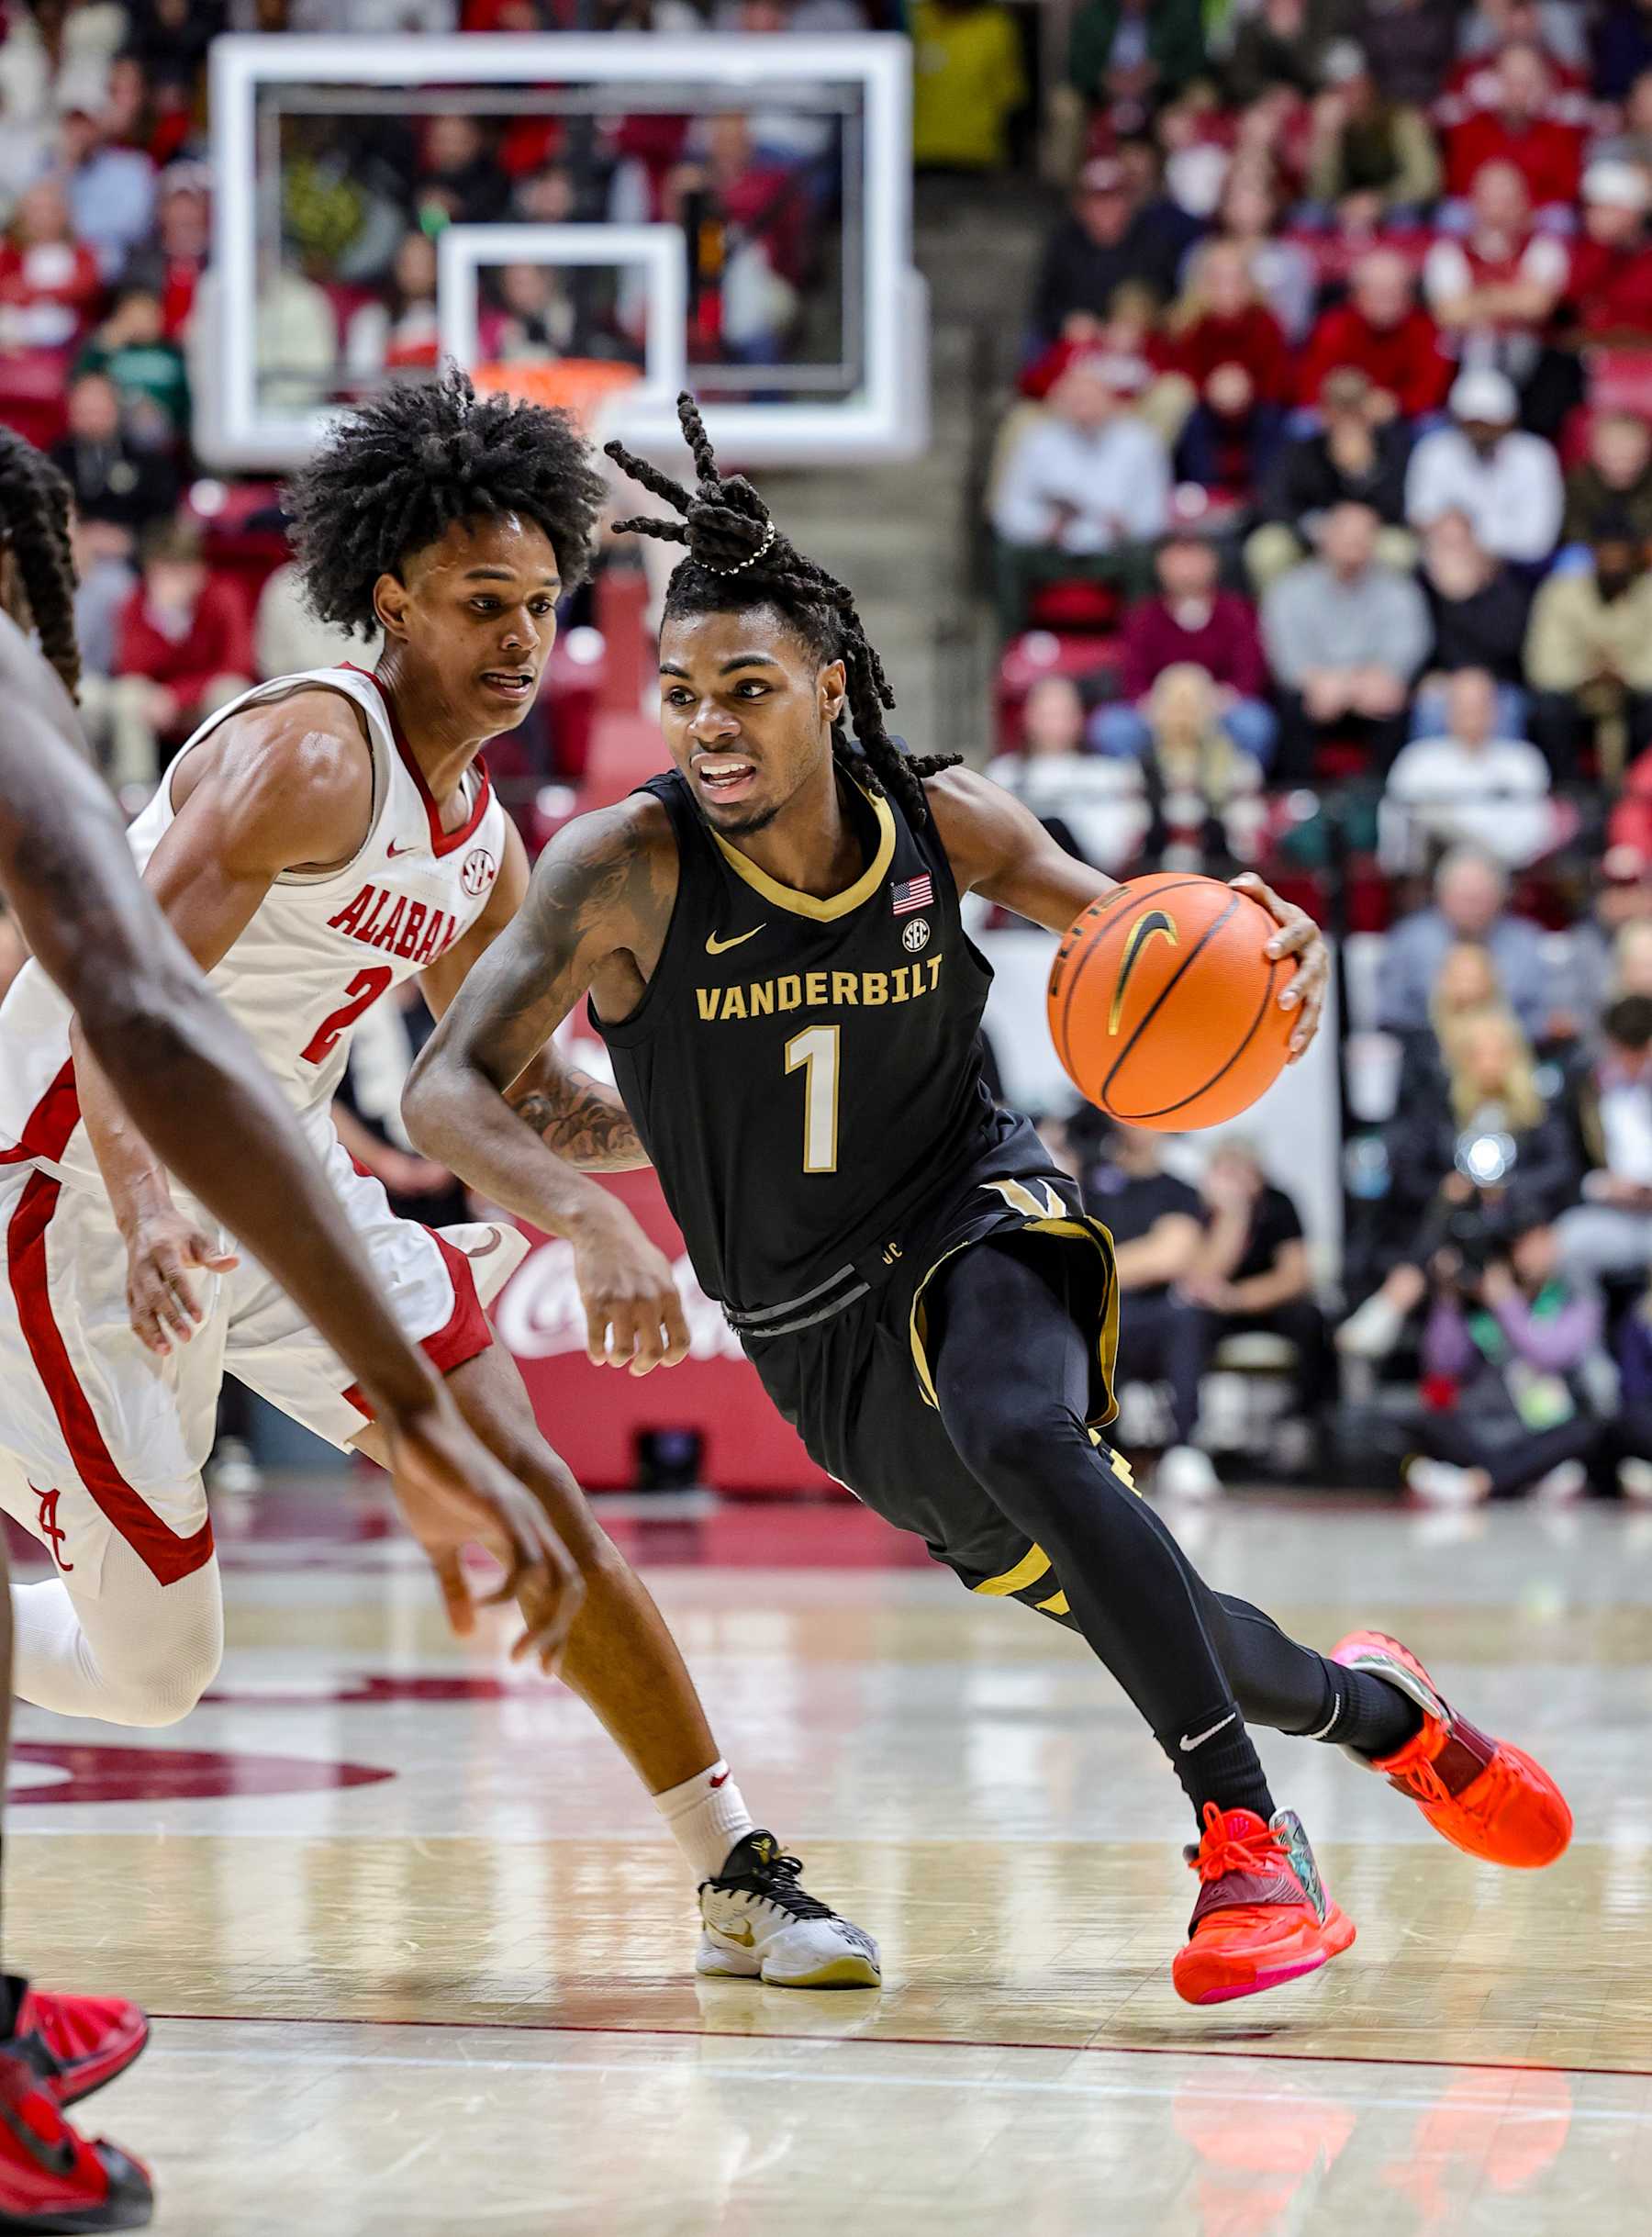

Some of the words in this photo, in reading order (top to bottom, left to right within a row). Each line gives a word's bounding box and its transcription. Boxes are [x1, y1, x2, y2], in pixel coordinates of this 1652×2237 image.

[904, 919, 929, 951] SEC
[299, 965, 394, 1065] 2
[696, 953, 943, 1021] VANDERBILT
[785, 1024, 841, 1173] 1
